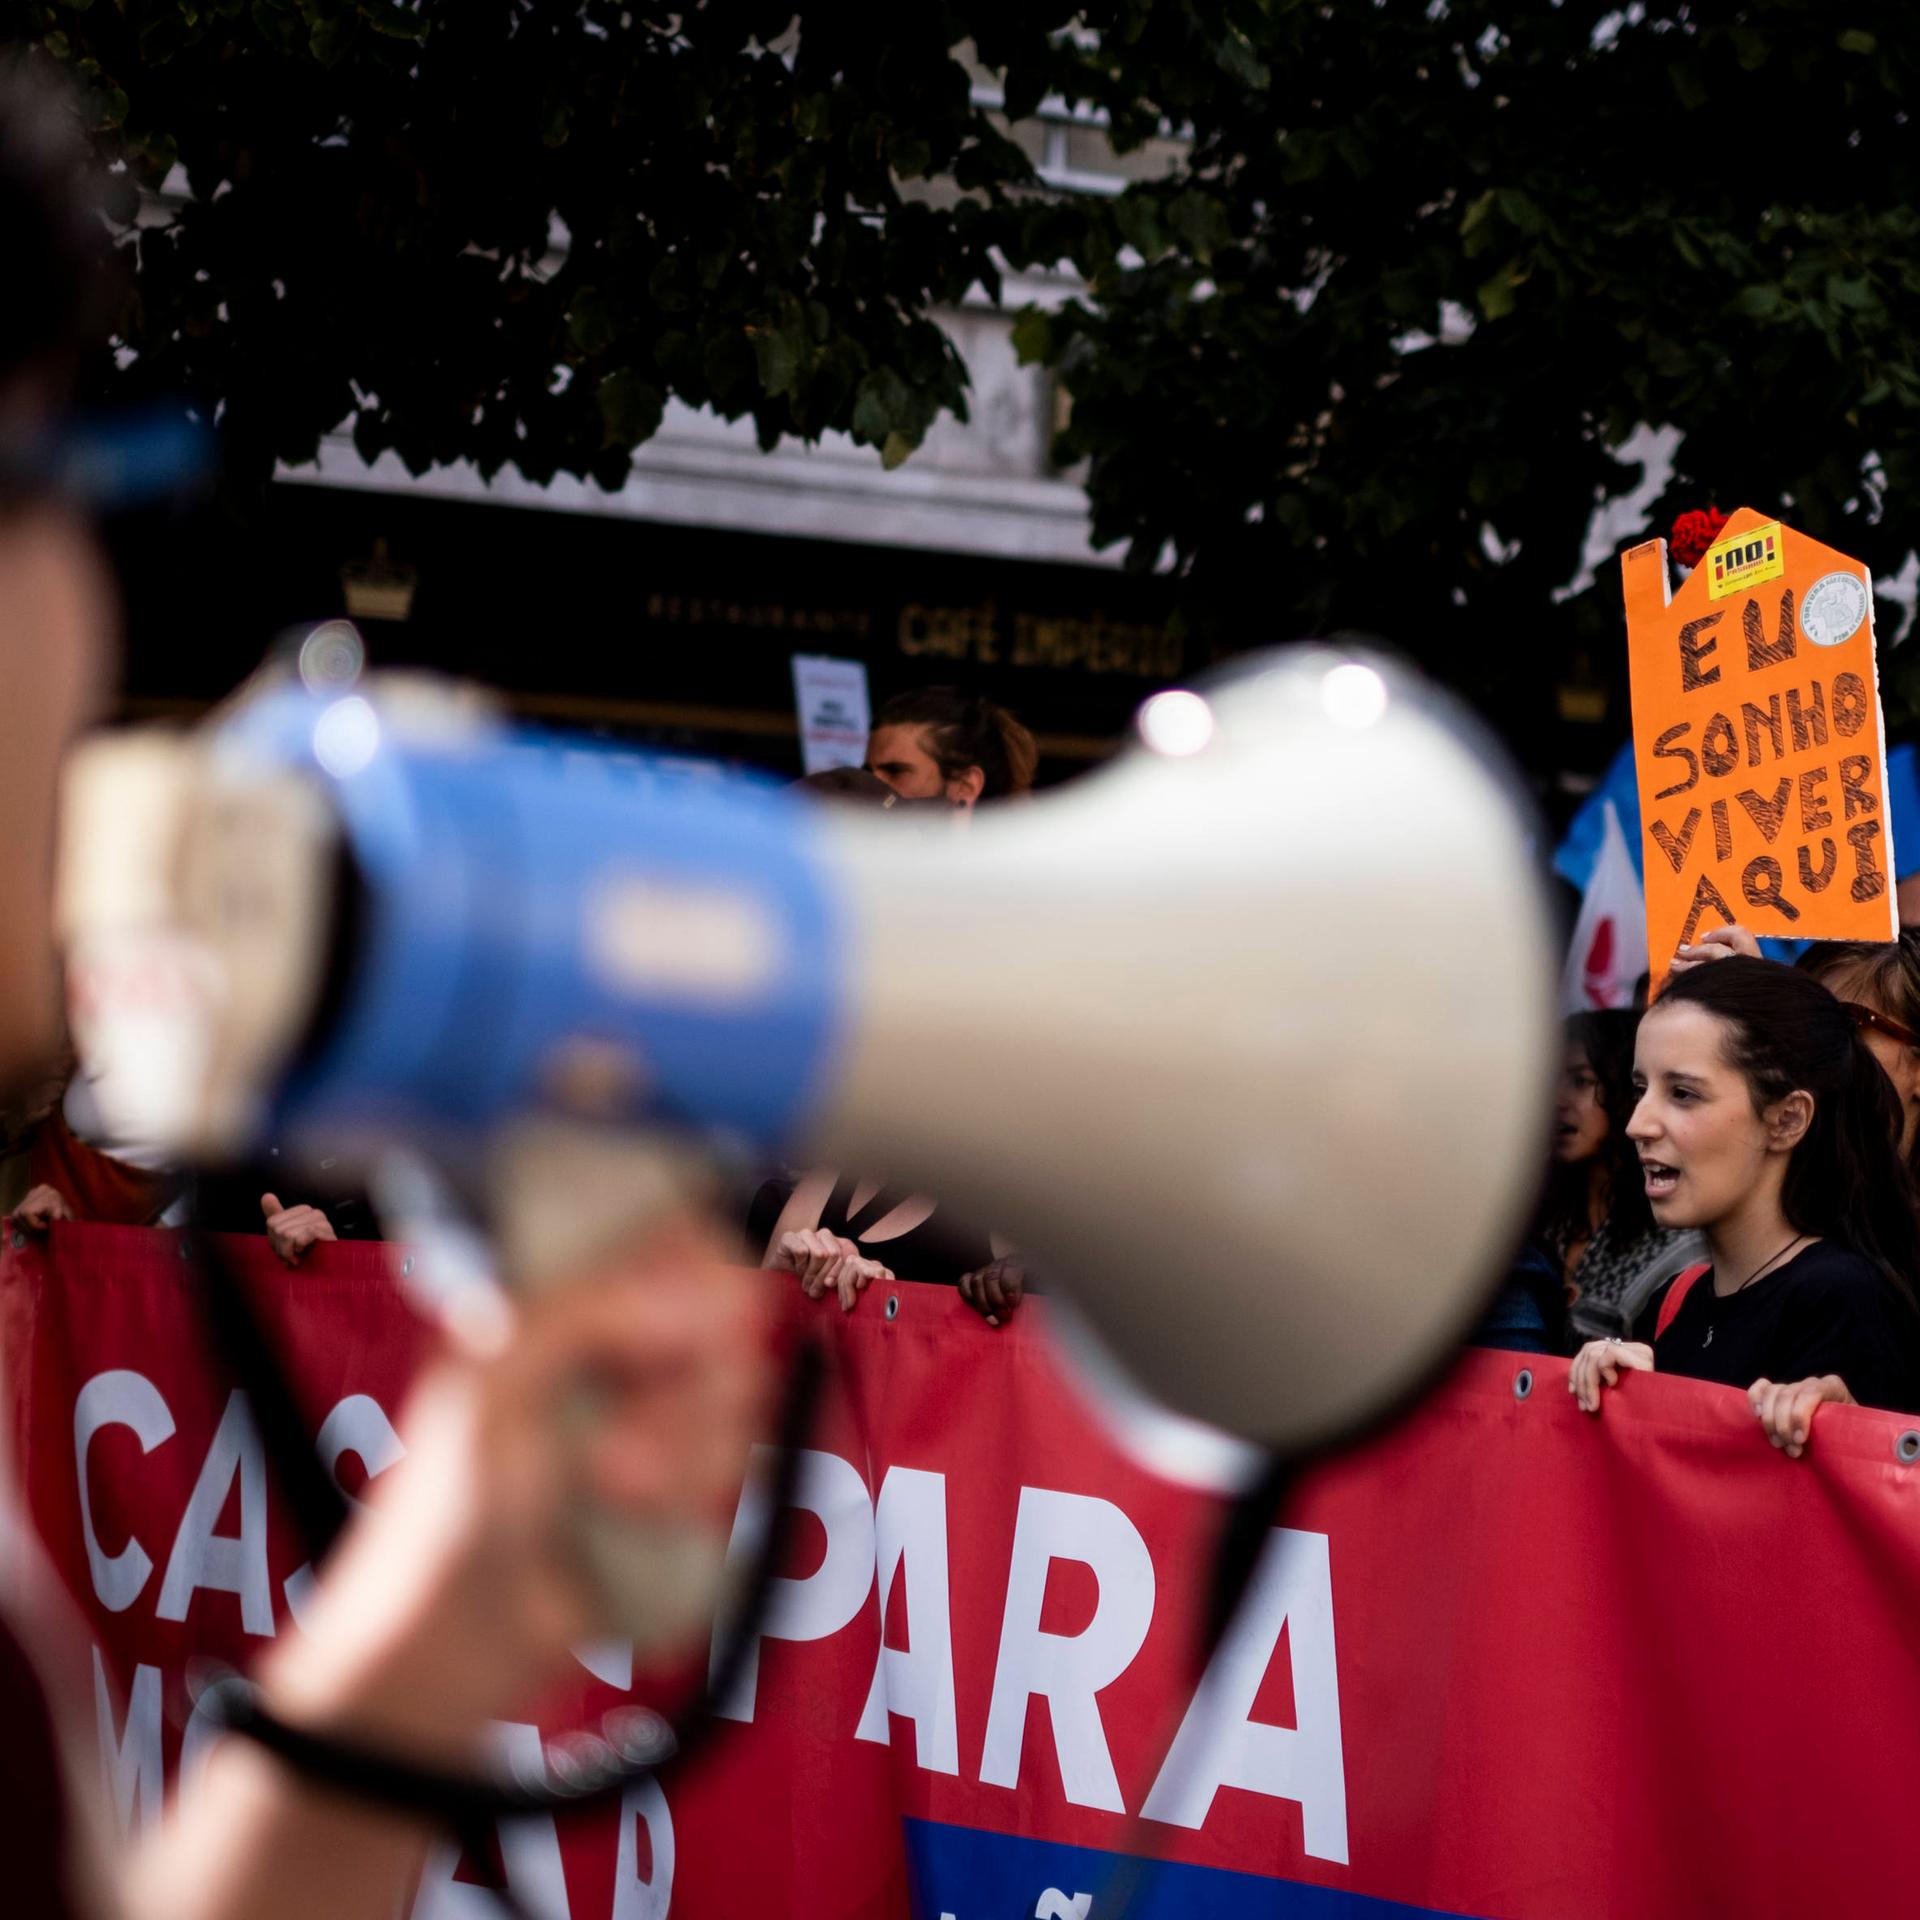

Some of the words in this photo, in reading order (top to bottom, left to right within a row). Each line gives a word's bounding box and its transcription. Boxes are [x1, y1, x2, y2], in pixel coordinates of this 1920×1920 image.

[897, 599, 998, 664] CAFÉ
[1679, 588, 1797, 692] EU
[1653, 672, 1867, 800] SONHO
[1649, 754, 1878, 873] VIVER
[1673, 819, 1885, 955] AQUI
[708, 1443, 1349, 1866] PARA
